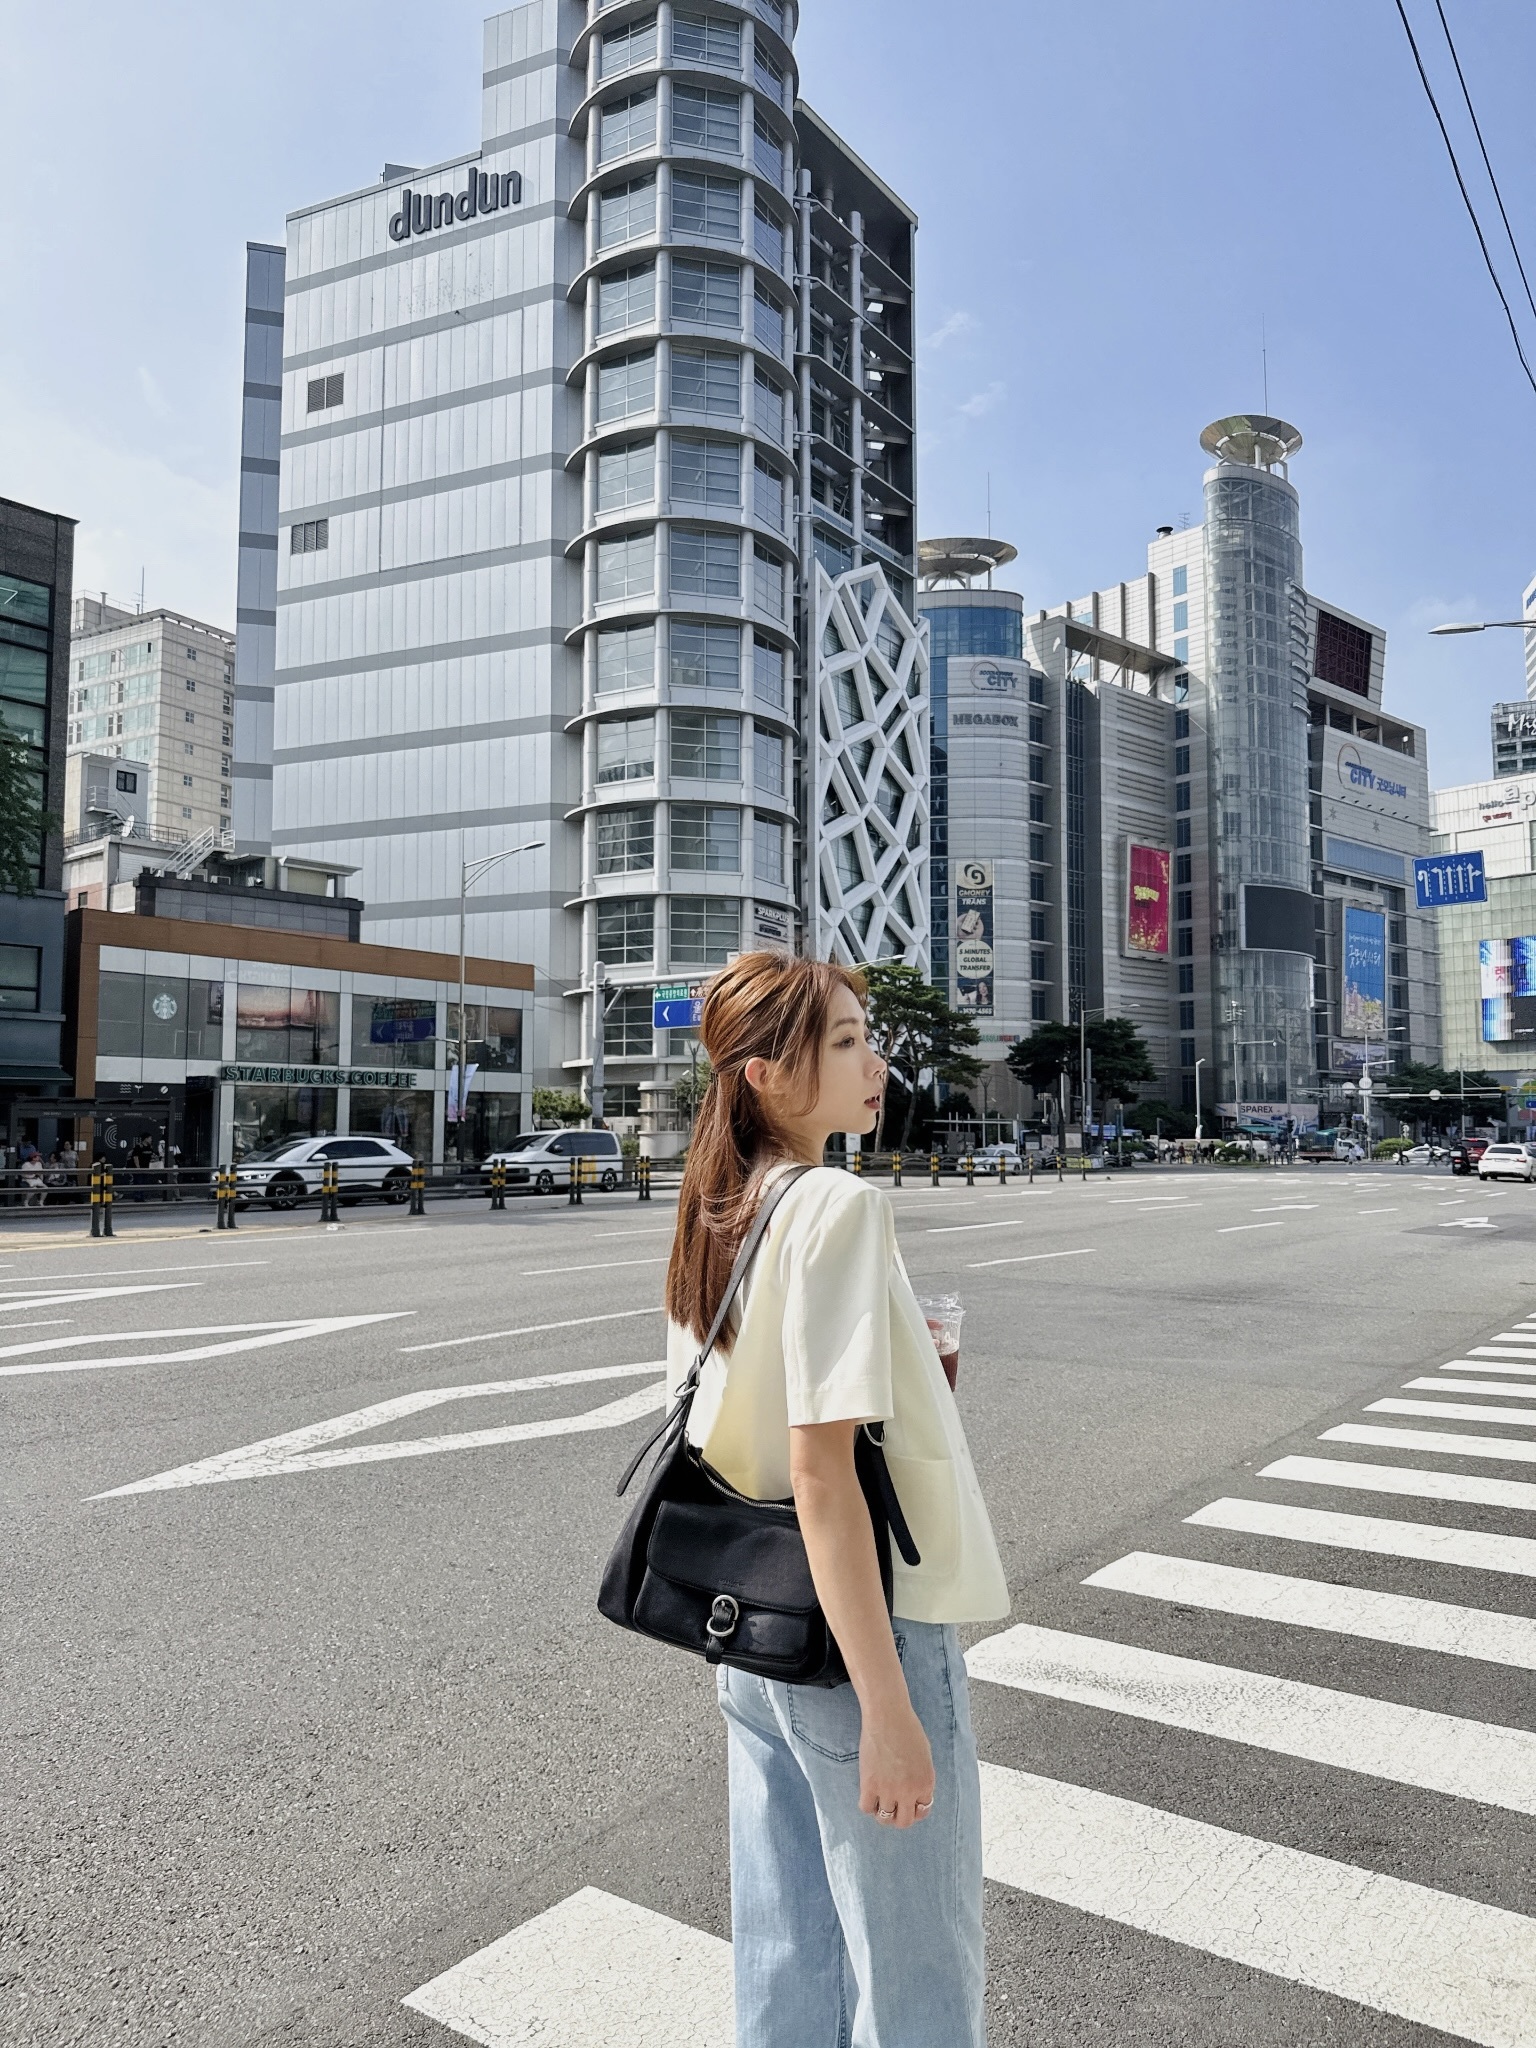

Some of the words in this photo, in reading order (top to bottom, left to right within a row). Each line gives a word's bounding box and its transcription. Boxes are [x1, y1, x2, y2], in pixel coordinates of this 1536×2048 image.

[389, 167, 521, 241] dundun
[987, 675, 1018, 688] CITY
[953, 713, 1019, 727] MEGABOX
[1350, 768, 1376, 789] CITY
[225, 1065, 346, 1085] STARBUCKS
[350, 1070, 418, 1088] COFFEE
[1240, 1105, 1273, 1114] SPAREX
